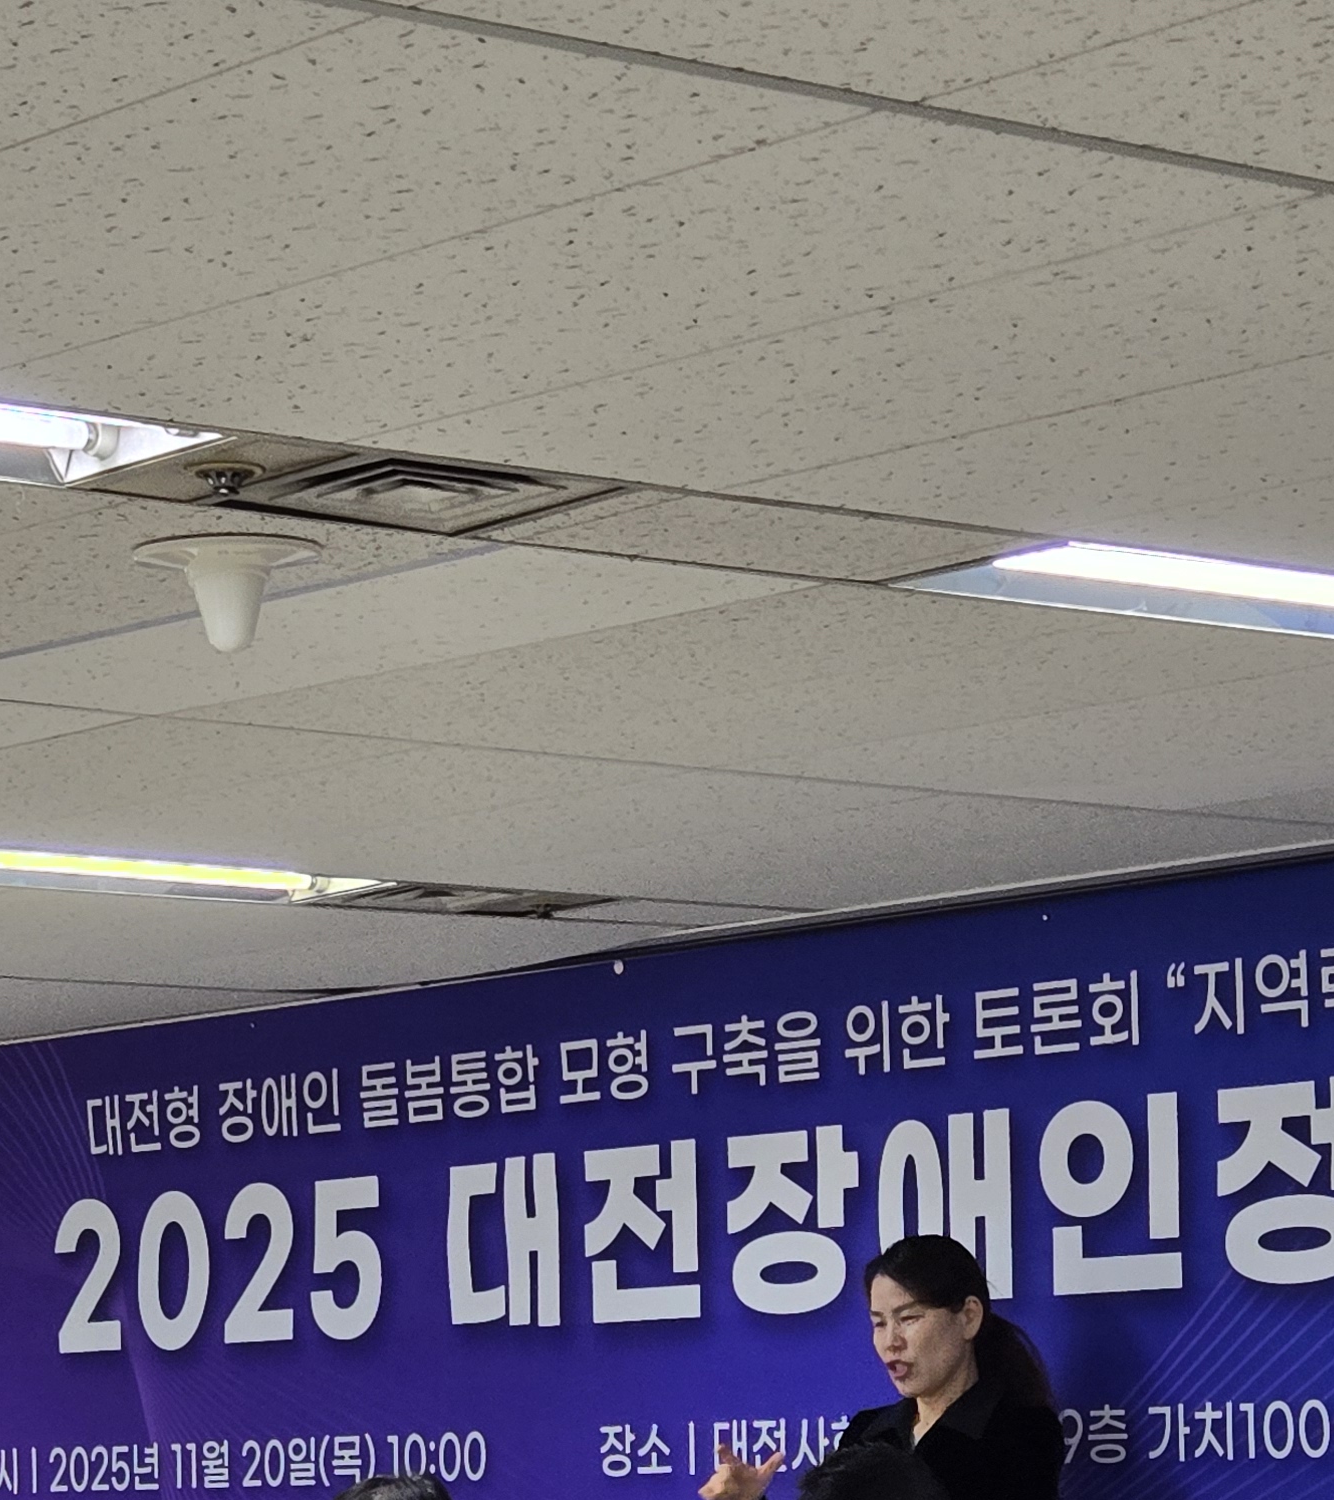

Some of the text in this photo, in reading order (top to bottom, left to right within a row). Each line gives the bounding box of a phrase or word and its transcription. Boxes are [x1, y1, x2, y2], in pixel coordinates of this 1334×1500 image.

[86, 1084, 201, 1156] 대전형
[218, 1067, 342, 1143] 장애인
[359, 1044, 540, 1129] 돌봄통합
[559, 1029, 649, 1105] 모형
[671, 1010, 822, 1095] 구축을
[844, 993, 950, 1076] 위한
[973, 969, 1140, 1060] 토론회
[54, 1175, 383, 1354] 2025
[48, 1441, 160, 1493] 2025년
[170, 1439, 230, 1489] 11월
[241, 1432, 376, 1488] 20일(목)
[386, 1430, 487, 1482] 10:00
[599, 1423, 673, 1478] 장소
